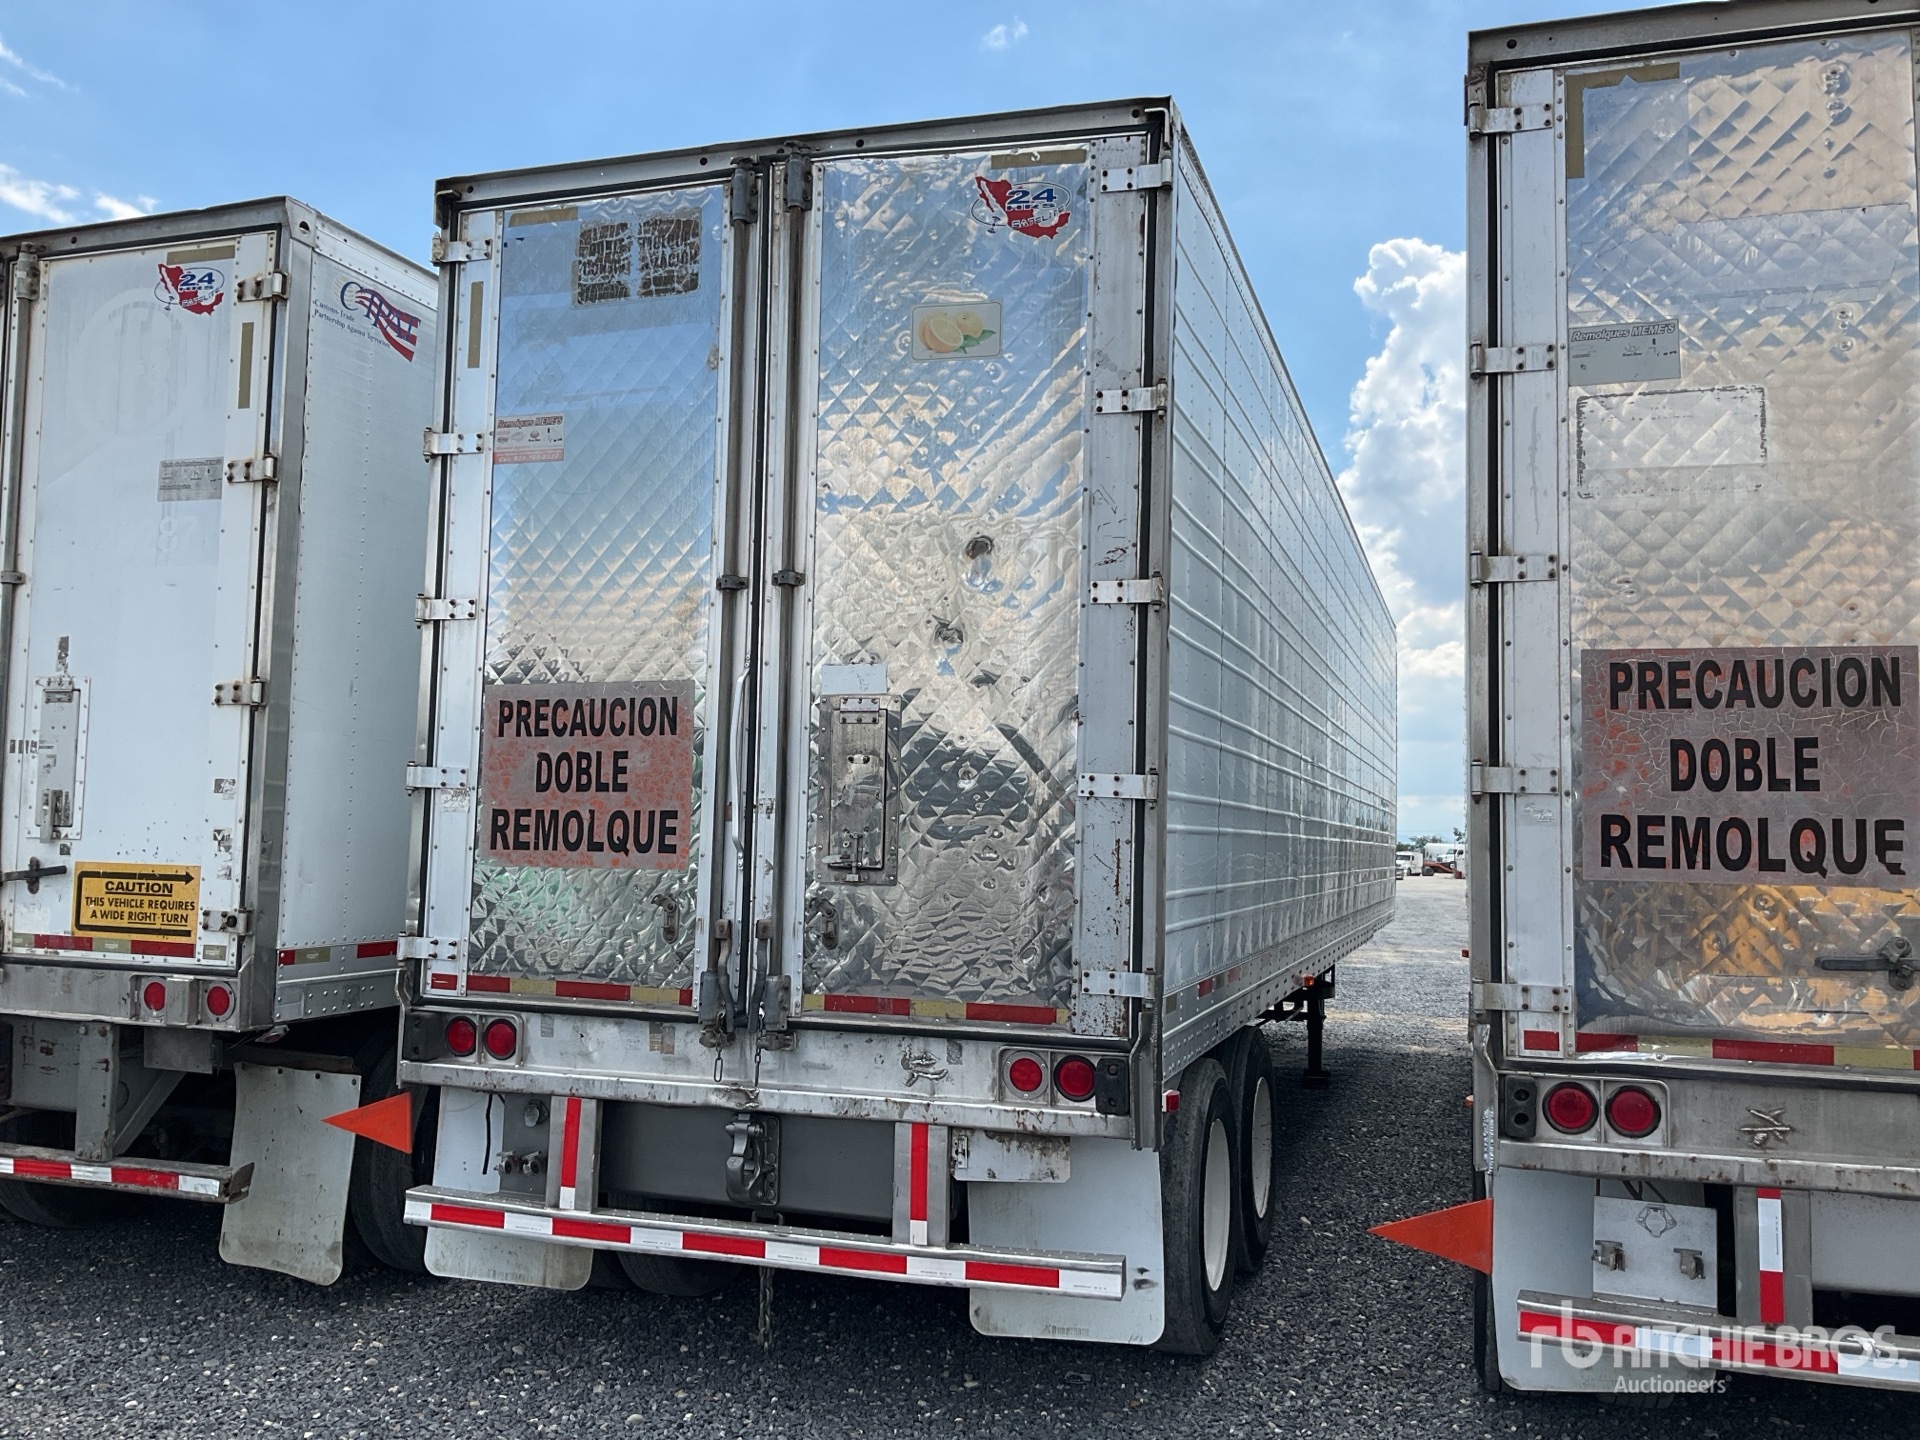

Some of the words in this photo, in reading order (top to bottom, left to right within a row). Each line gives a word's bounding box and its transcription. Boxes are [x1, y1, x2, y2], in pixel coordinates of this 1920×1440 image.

[1006, 188, 1057, 205] 24
[1006, 203, 1056, 211] HRS
[179, 272, 215, 286] 24
[314, 308, 346, 330] Partnership
[347, 324, 366, 337] Against
[1571, 328, 1631, 342] Remolques
[1631, 323, 1675, 336] MEME'S
[1609, 656, 1902, 710] PRECAUCION
[498, 696, 678, 737] PRECAUCION
[535, 750, 629, 793] DOBLE
[1669, 736, 1821, 792] DOBLE
[490, 808, 679, 857] REMOLQUE
[1600, 814, 1906, 879] REMOLQUE
[105, 881, 173, 894] CAUTION
[84, 896, 105, 907] THIS
[107, 897, 145, 909] VEHICLE
[147, 899, 195, 911] REQUIRES
[90, 909, 98, 919] A
[99, 910, 125, 920] WIDE
[127, 911, 158, 922] RIGHT
[160, 913, 189, 923] TURN
